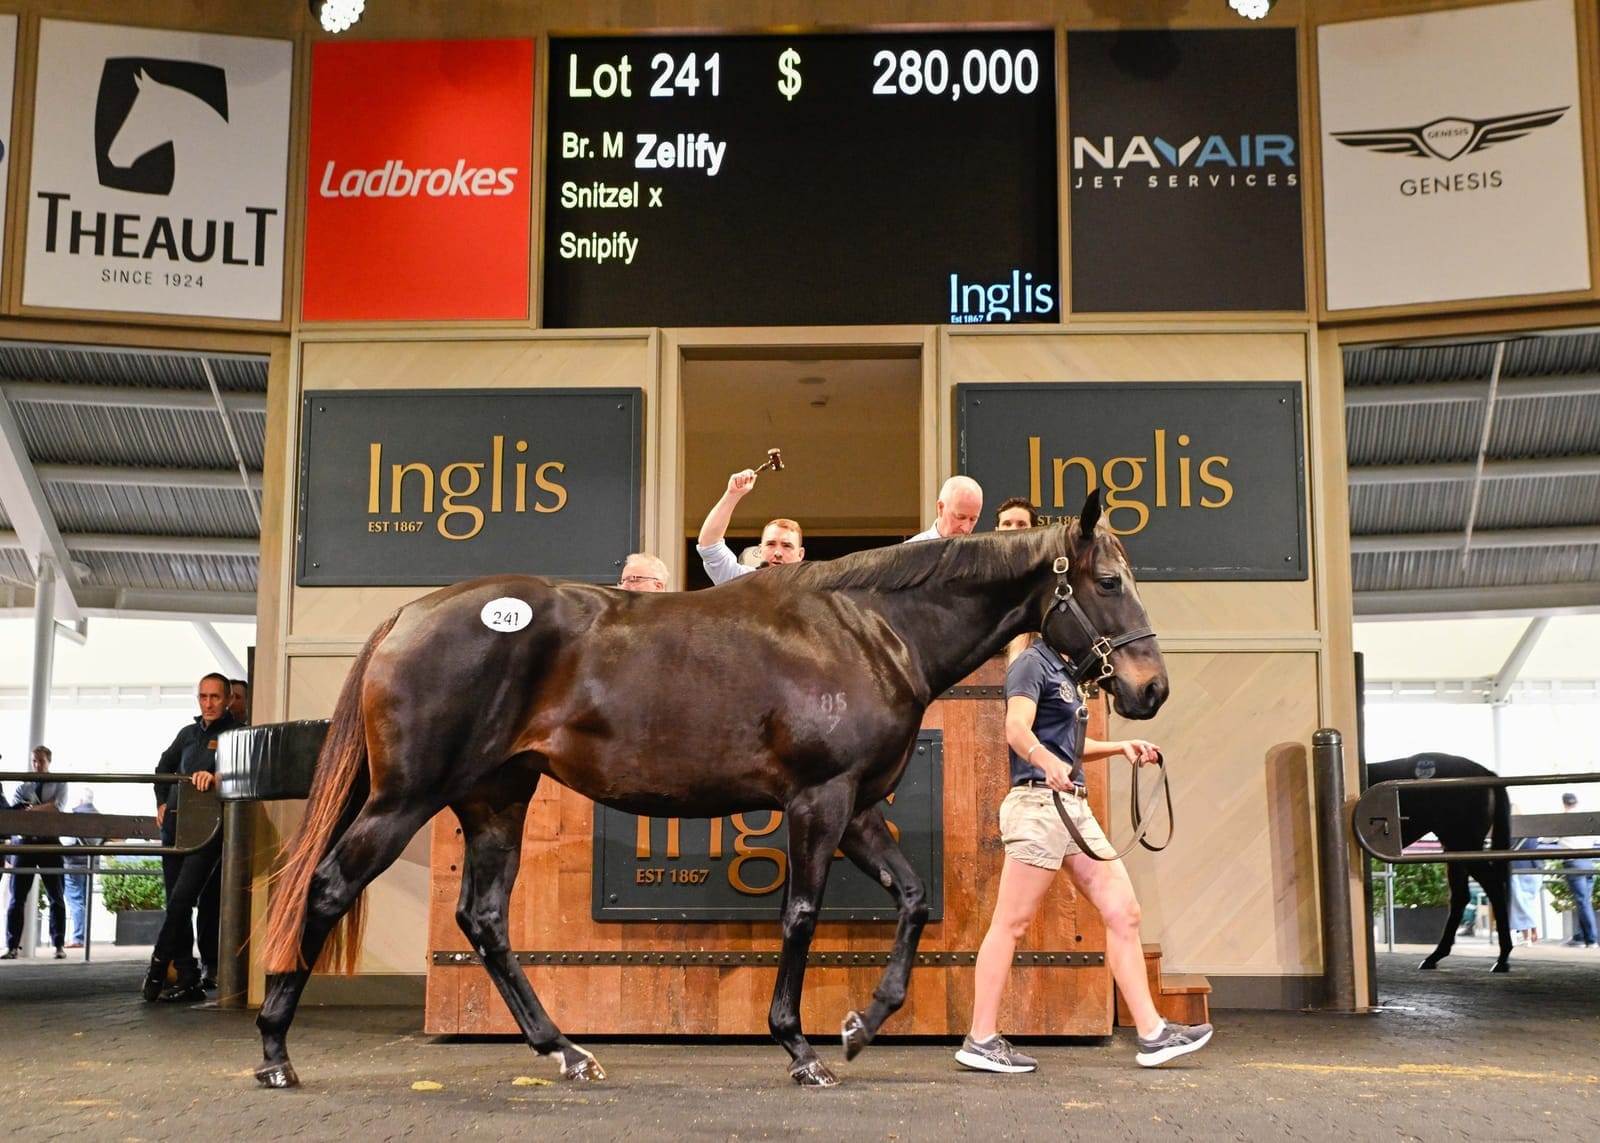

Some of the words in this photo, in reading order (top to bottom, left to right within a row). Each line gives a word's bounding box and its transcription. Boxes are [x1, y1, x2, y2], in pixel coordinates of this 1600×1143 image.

[569, 54, 632, 98] Lot
[650, 52, 720, 97] 241
[777, 47, 802, 101] $
[872, 49, 1039, 101] 280,000
[1427, 127, 1469, 140] GENESIS
[562, 132, 594, 159] Br.
[602, 132, 624, 159] M
[635, 133, 727, 176] Zelify
[1074, 134, 1295, 169] NAVAIR
[320, 159, 518, 199] Ladbrokes
[1075, 175, 1124, 189] JET
[1148, 174, 1298, 188] SERVICES
[1400, 170, 1503, 196] GENESIS
[560, 182, 639, 209] Snitzel
[648, 187, 663, 207] x
[37, 191, 278, 267] THEAULT
[559, 232, 639, 264] Snipify
[101, 269, 153, 286] SINCE
[164, 274, 205, 288] 1924
[950, 269, 1054, 322] Inglis
[367, 435, 568, 540] Inglis
[1028, 429, 1234, 535] Inglis
[368, 521, 390, 532] EST
[393, 521, 423, 533] 1867
[493, 611, 519, 626] 241
[635, 869, 665, 883] EST
[670, 869, 709, 884] 1867
